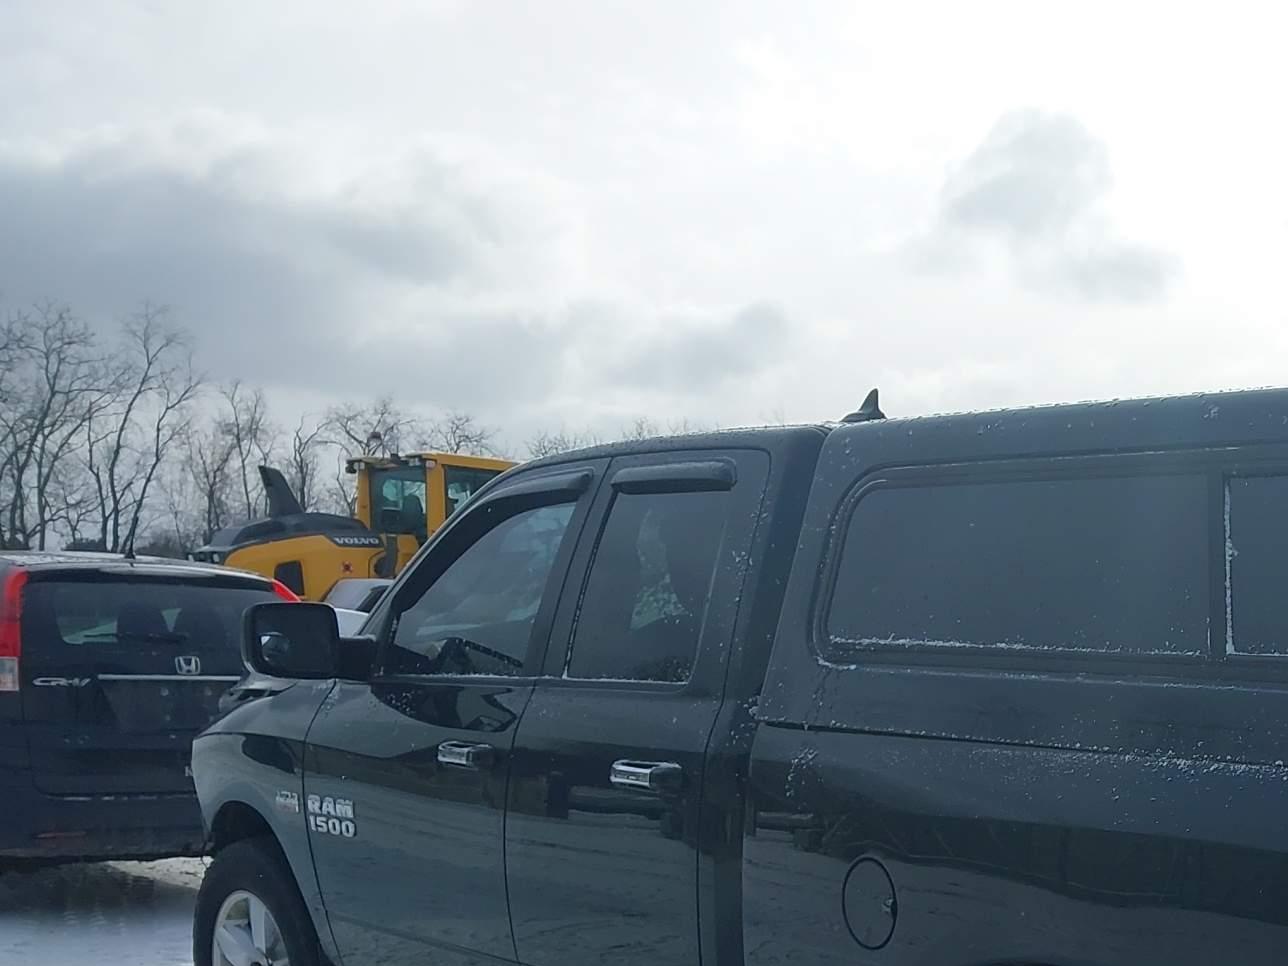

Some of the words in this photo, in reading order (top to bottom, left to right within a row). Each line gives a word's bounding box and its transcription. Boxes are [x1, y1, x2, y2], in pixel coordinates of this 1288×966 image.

[334, 536, 379, 545] VOLVO
[32, 677, 91, 687] CR-V
[307, 794, 354, 818] RAM
[309, 815, 356, 838] 1500
